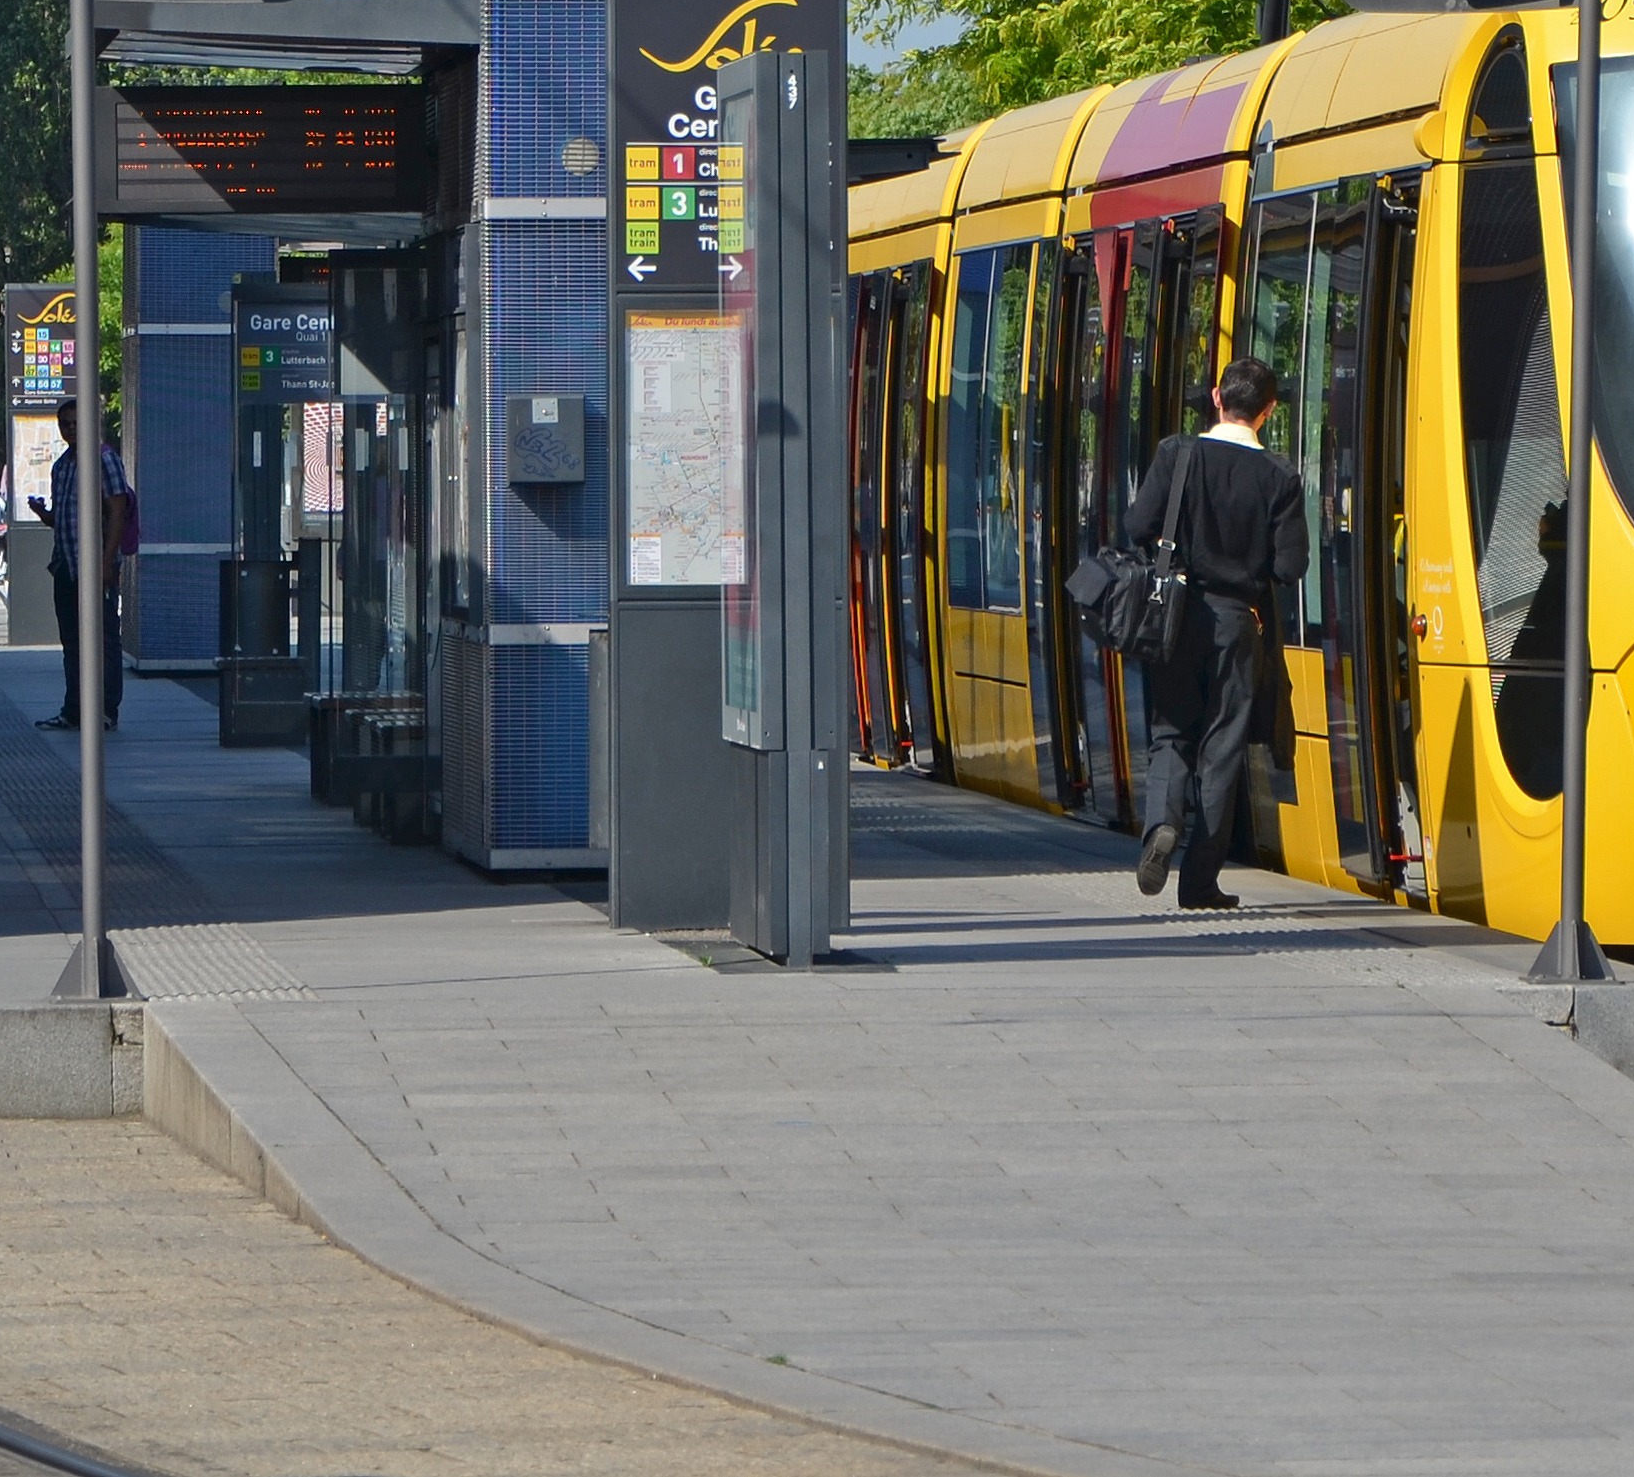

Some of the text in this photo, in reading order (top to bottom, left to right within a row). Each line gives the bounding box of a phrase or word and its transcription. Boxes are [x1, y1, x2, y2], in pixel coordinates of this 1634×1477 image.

[629, 159, 656, 168] tram
[672, 152, 684, 174] 1
[629, 198, 656, 208] tram
[671, 191, 688, 216] 3
[629, 228, 656, 238] tram
[629, 238, 656, 248] train
[250, 314, 291, 331] Gare
[664, 317, 679, 326] Du
[681, 317, 706, 326] lundi
[295, 331, 318, 342] Quai
[265, 350, 274, 363] 3
[280, 355, 326, 365] Lutterbach
[281, 379, 307, 389] Thann
